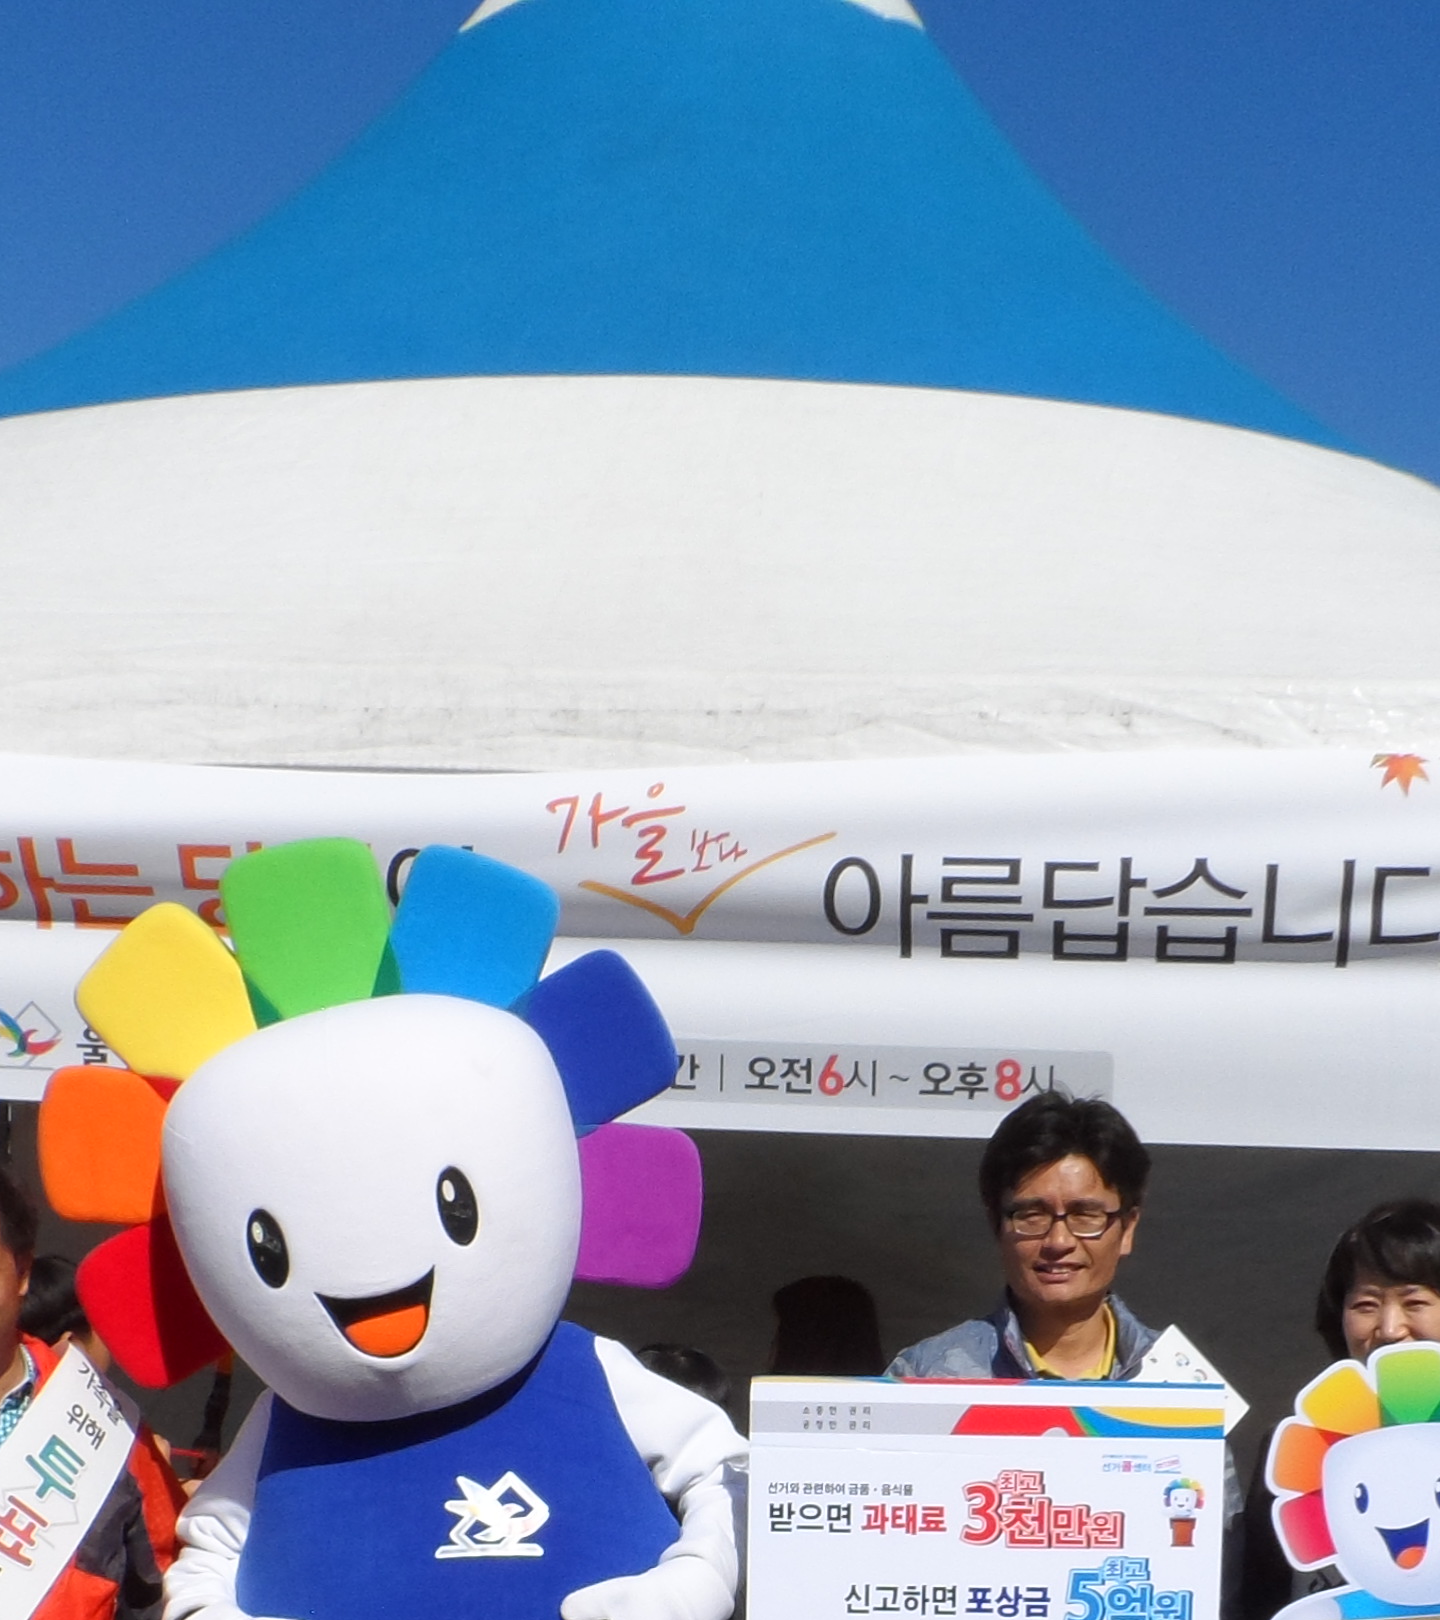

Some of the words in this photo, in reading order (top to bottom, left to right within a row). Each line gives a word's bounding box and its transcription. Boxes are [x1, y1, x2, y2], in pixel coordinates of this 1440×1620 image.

[66, 1402, 107, 1451] 위해
[767, 1482, 801, 1496] 선거와
[802, 1482, 847, 1497] 관련하여
[997, 1469, 1046, 1494] 최고
[767, 1502, 853, 1535] 받으면
[860, 1503, 948, 1535] 과태료
[960, 1479, 1126, 1550] 3천만원
[1104, 1556, 1151, 1581] 최고
[843, 1583, 959, 1617] 신고하면
[964, 1584, 1053, 1618] 포상금
